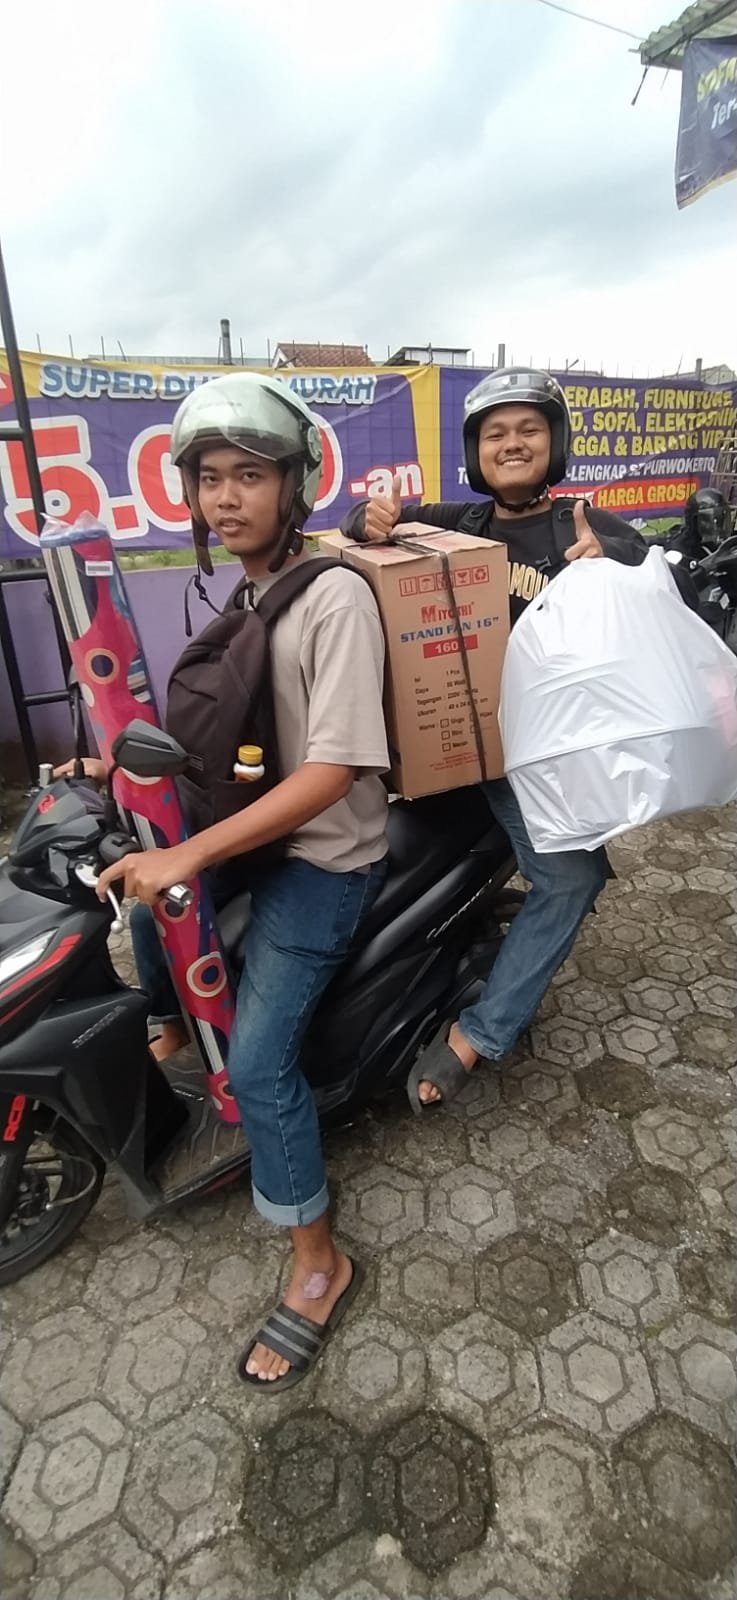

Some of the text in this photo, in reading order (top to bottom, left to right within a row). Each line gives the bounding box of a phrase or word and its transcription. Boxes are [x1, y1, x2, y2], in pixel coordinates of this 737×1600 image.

[43, 364, 154, 395] SUPER
[564, 386, 733, 412] ERABAH, FURNITURE
[592, 411, 641, 434] SOFA,
[573, 435, 611, 457] GGA
[614, 435, 628, 456] &
[631, 431, 698, 457] BARANG
[597, 486, 645, 508] HARGA
[400, 627, 444, 643] STAND
[446, 621, 472, 635] FAN
